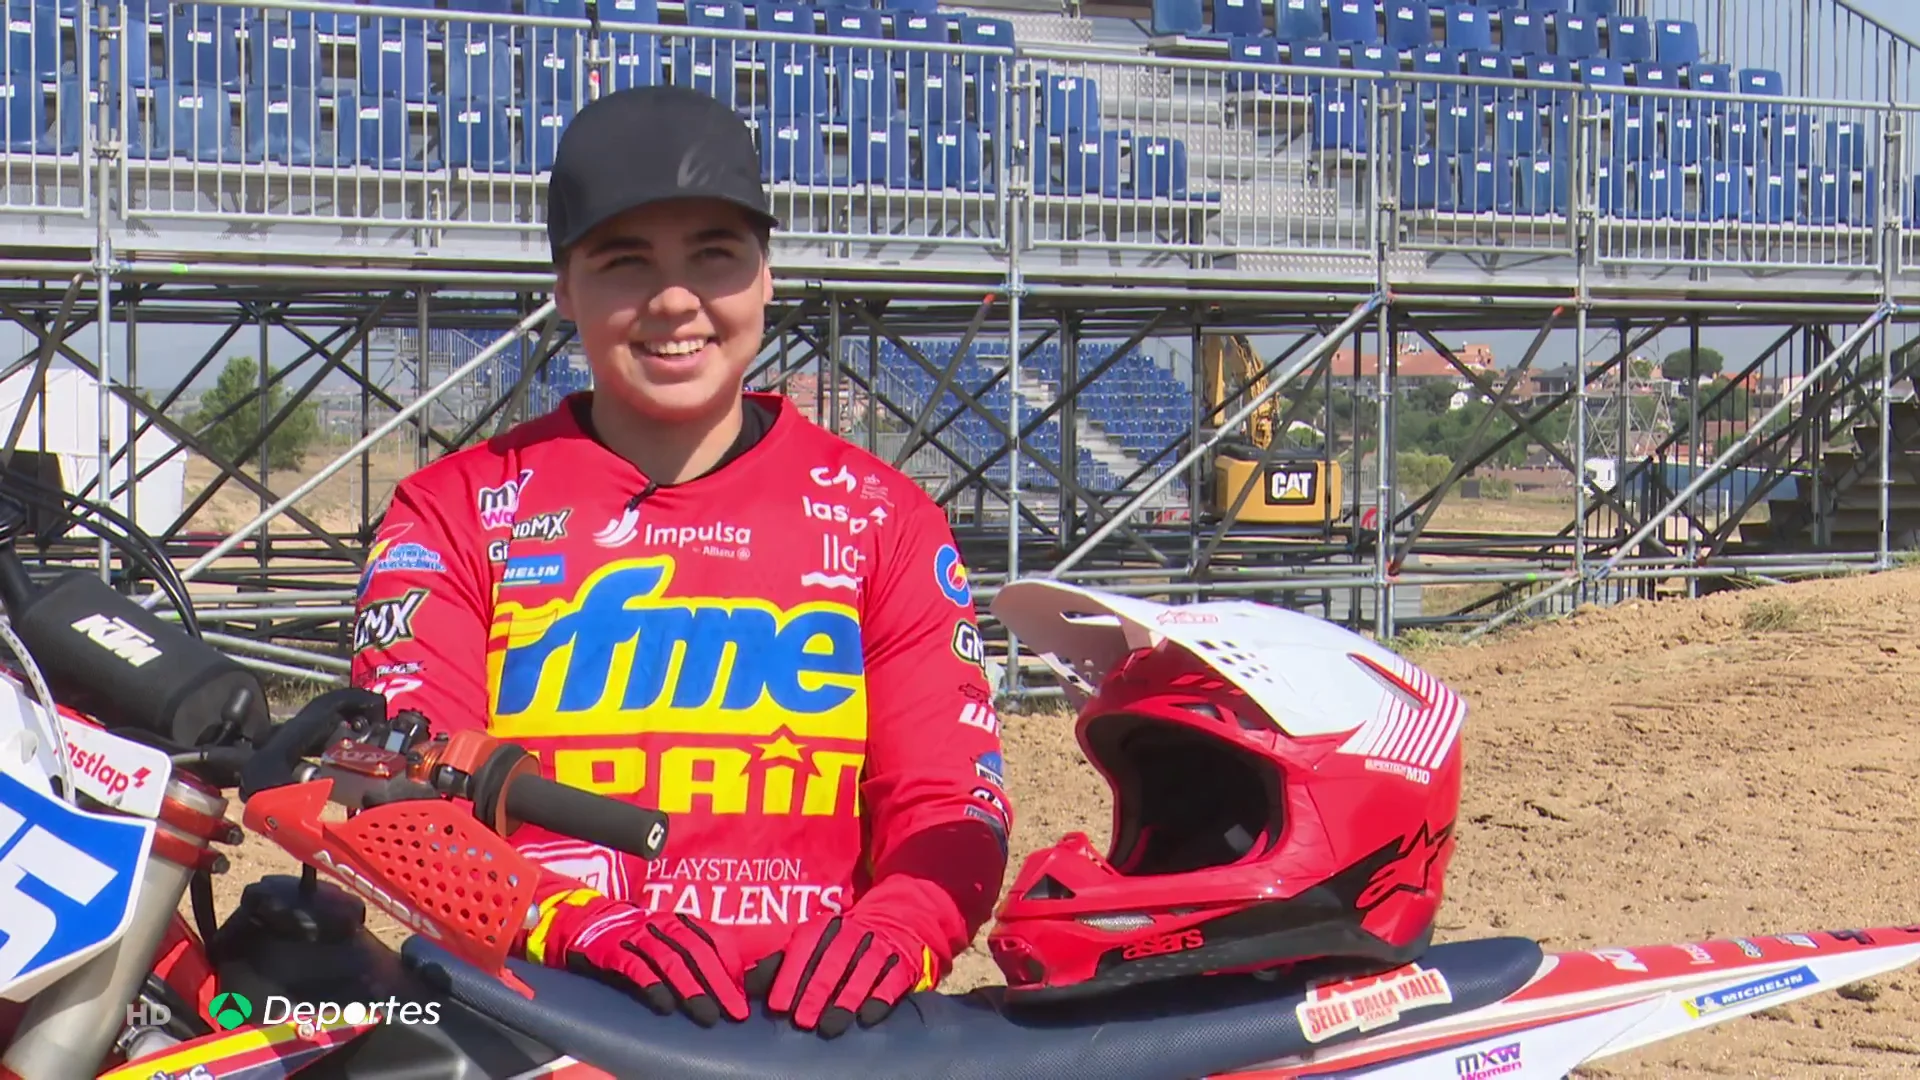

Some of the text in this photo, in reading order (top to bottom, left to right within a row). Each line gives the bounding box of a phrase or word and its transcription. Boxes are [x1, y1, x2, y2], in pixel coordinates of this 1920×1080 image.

[1271, 472, 1312, 499] CAT
[644, 521, 752, 548] Impulsa
[71, 613, 163, 668] KTM
[496, 564, 863, 715] rfme
[645, 857, 802, 882] PLAYSTATION
[642, 883, 845, 926] TALENTS
[1306, 1001, 1352, 1035] SELLE
[1352, 987, 1399, 1017] DALLA
[1397, 972, 1446, 1001] VALLE
[1721, 973, 1805, 1005] MICHELIN
